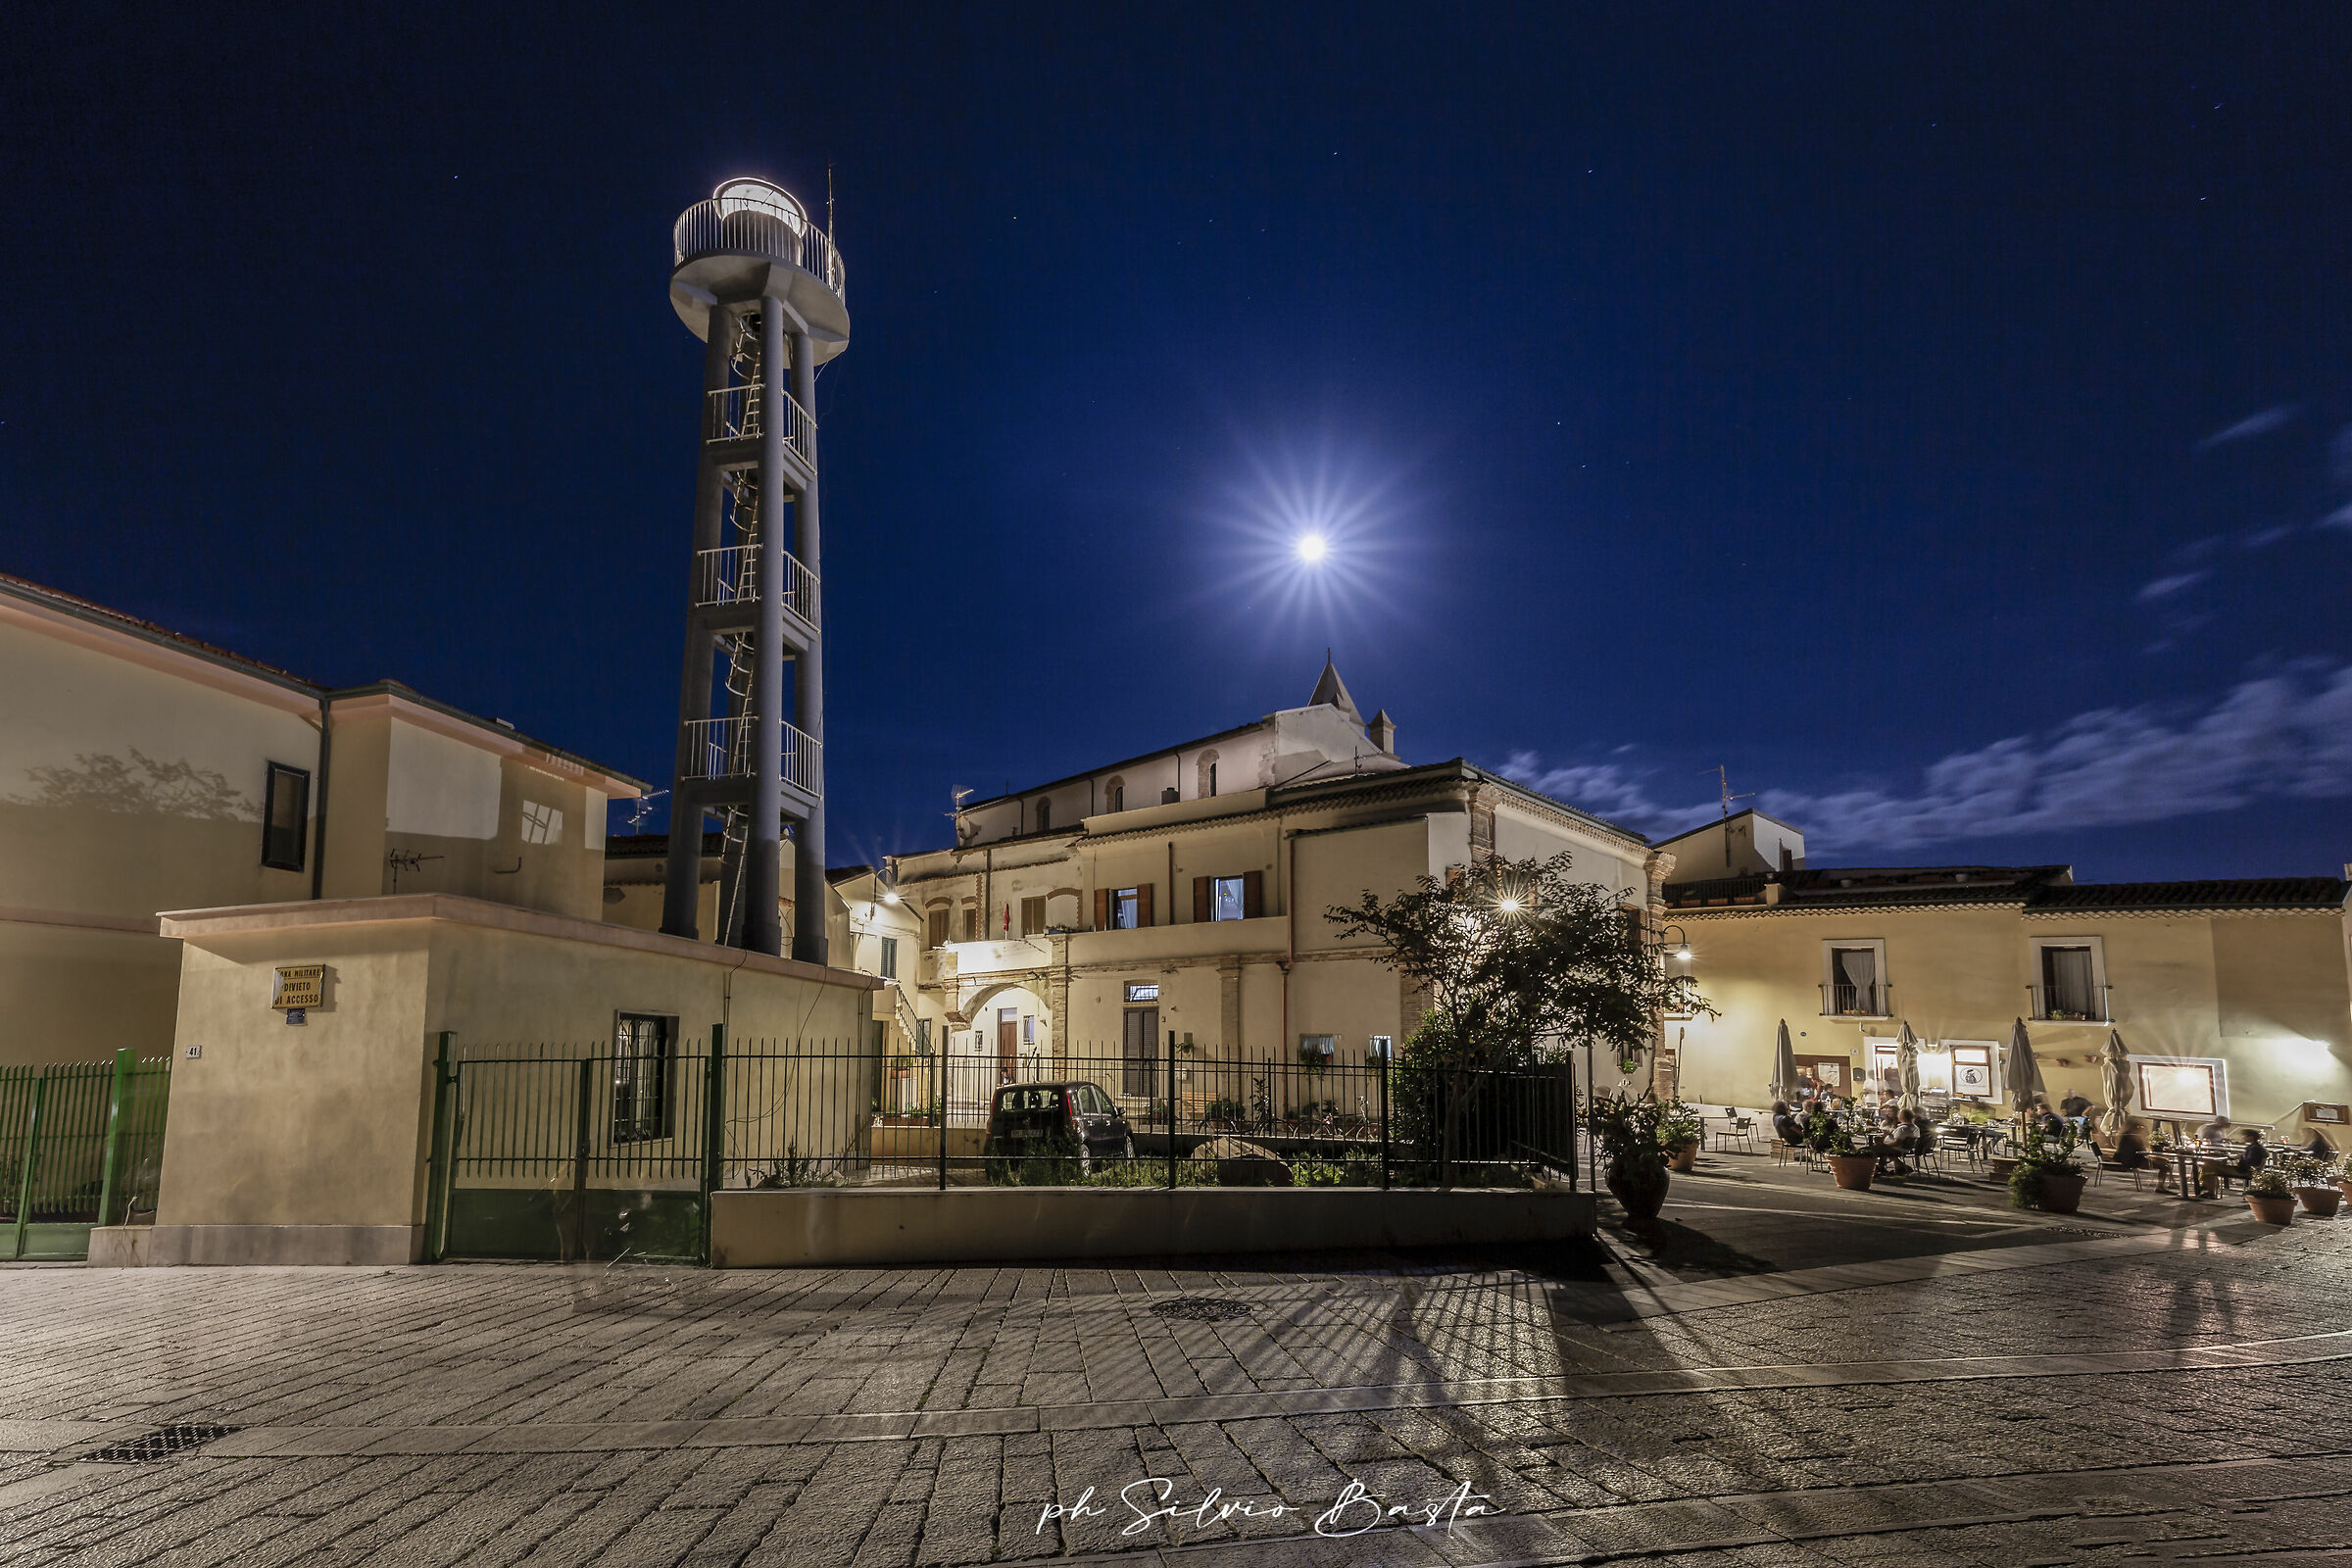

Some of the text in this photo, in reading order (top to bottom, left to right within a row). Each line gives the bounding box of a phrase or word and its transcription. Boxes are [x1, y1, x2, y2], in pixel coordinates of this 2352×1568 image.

[284, 982, 311, 992] DIVIETO
[286, 994, 318, 1004] ACCESSO
[189, 1047, 197, 1056] 41
